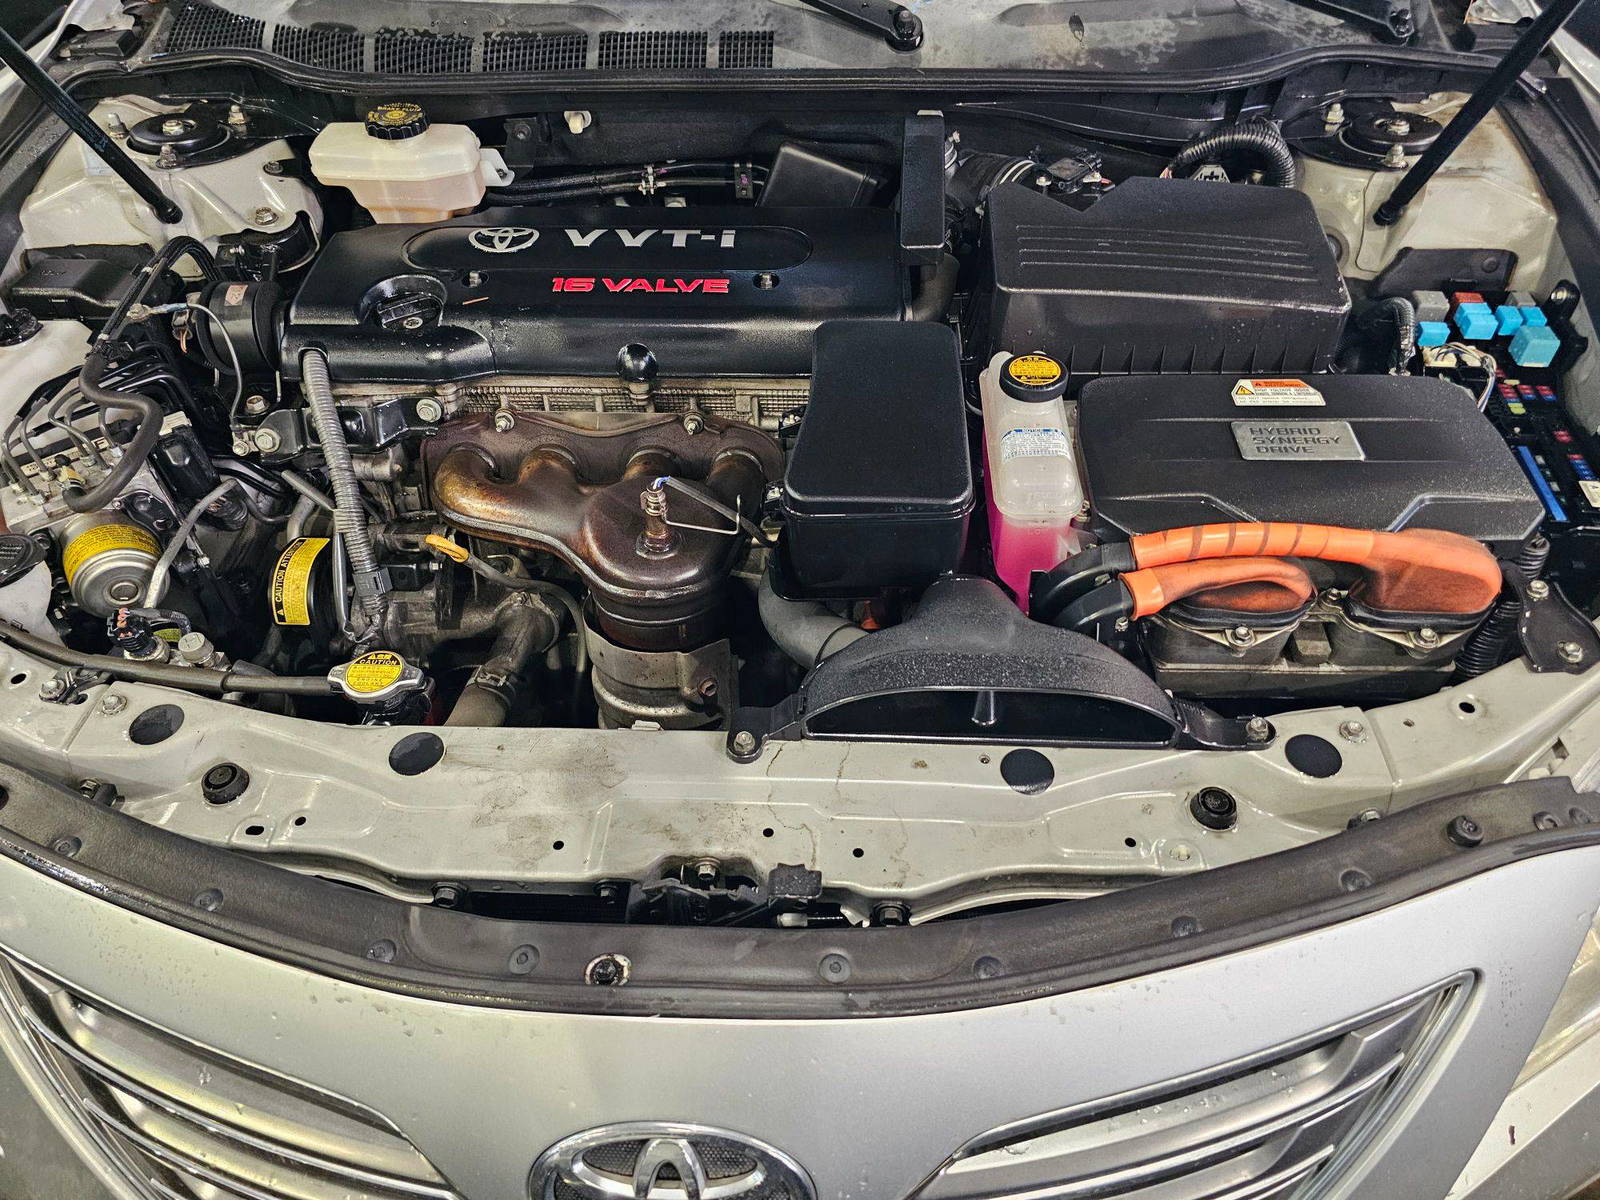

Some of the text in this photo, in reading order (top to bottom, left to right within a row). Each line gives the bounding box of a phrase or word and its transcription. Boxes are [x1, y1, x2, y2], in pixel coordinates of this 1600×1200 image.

[564, 229, 736, 248] VVT-i
[552, 277, 730, 293] 16 VALVE
[1249, 427, 1321, 435] HYBRID
[1252, 436, 1340, 445] SYNERGY
[1255, 446, 1315, 454] DRIVE
[275, 569, 285, 603] CAUTION
